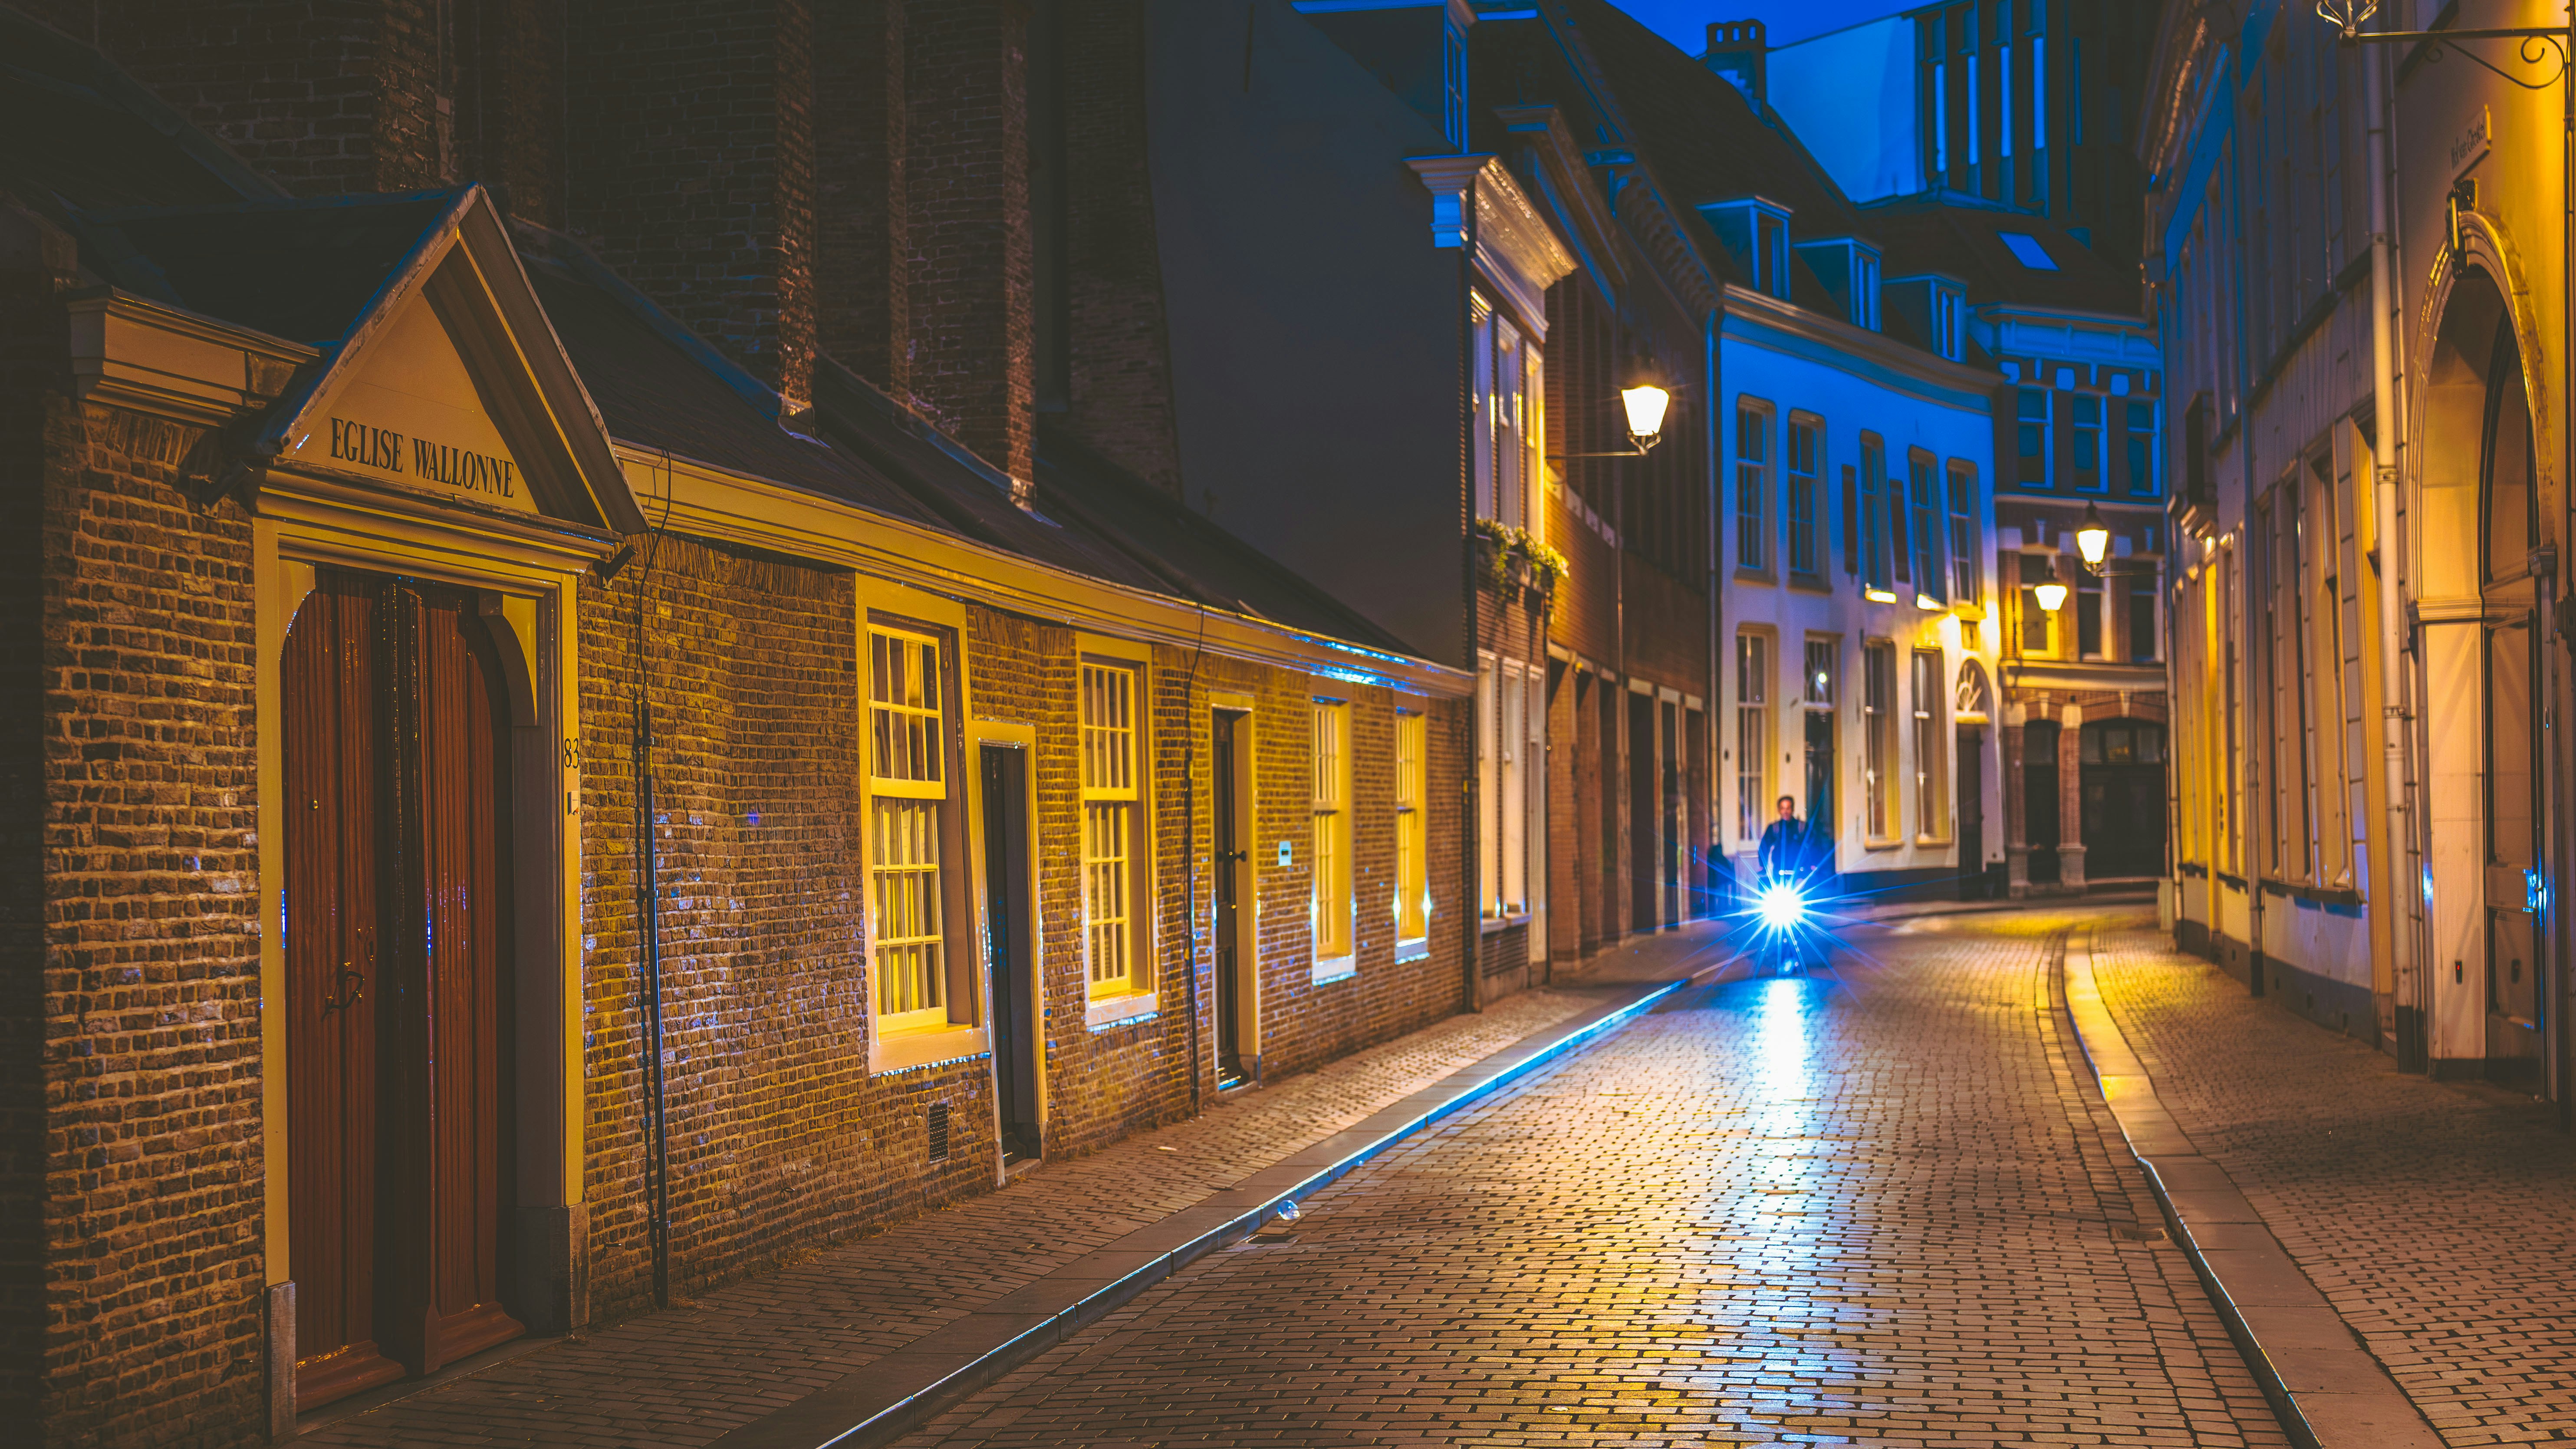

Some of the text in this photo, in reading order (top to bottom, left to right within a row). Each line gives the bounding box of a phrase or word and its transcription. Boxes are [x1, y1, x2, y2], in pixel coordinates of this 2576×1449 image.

[331, 417, 514, 498] EGLISE WALLONNE
[564, 738, 579, 769] 83
